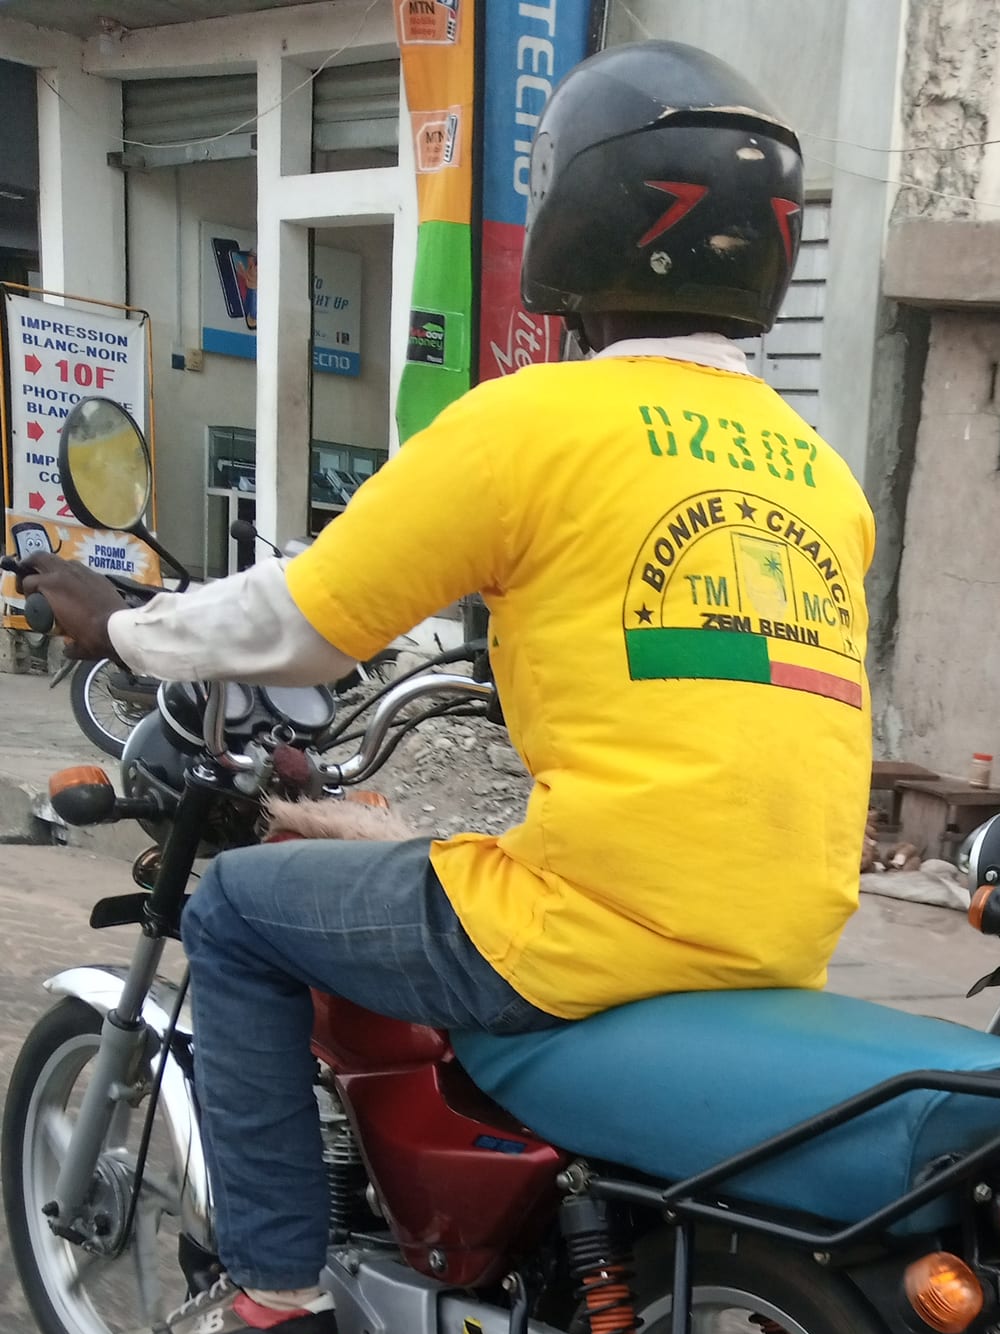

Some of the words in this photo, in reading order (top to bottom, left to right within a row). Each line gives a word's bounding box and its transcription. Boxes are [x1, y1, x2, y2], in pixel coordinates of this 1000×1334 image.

[334, 296, 349, 310] UP
[21, 316, 128, 347] IMPRESSION
[22, 333, 128, 363] BLANC-NOIR
[55, 359, 116, 389] 10F
[94, 544, 126, 560] PROMO
[641, 497, 726, 594] BONNE
[88, 556, 135, 573] PORTABLE!
[766, 510, 850, 629] CHANCE
[683, 574, 729, 607] TM
[700, 612, 753, 633] ZEM
[759, 618, 820, 647] BENIN
